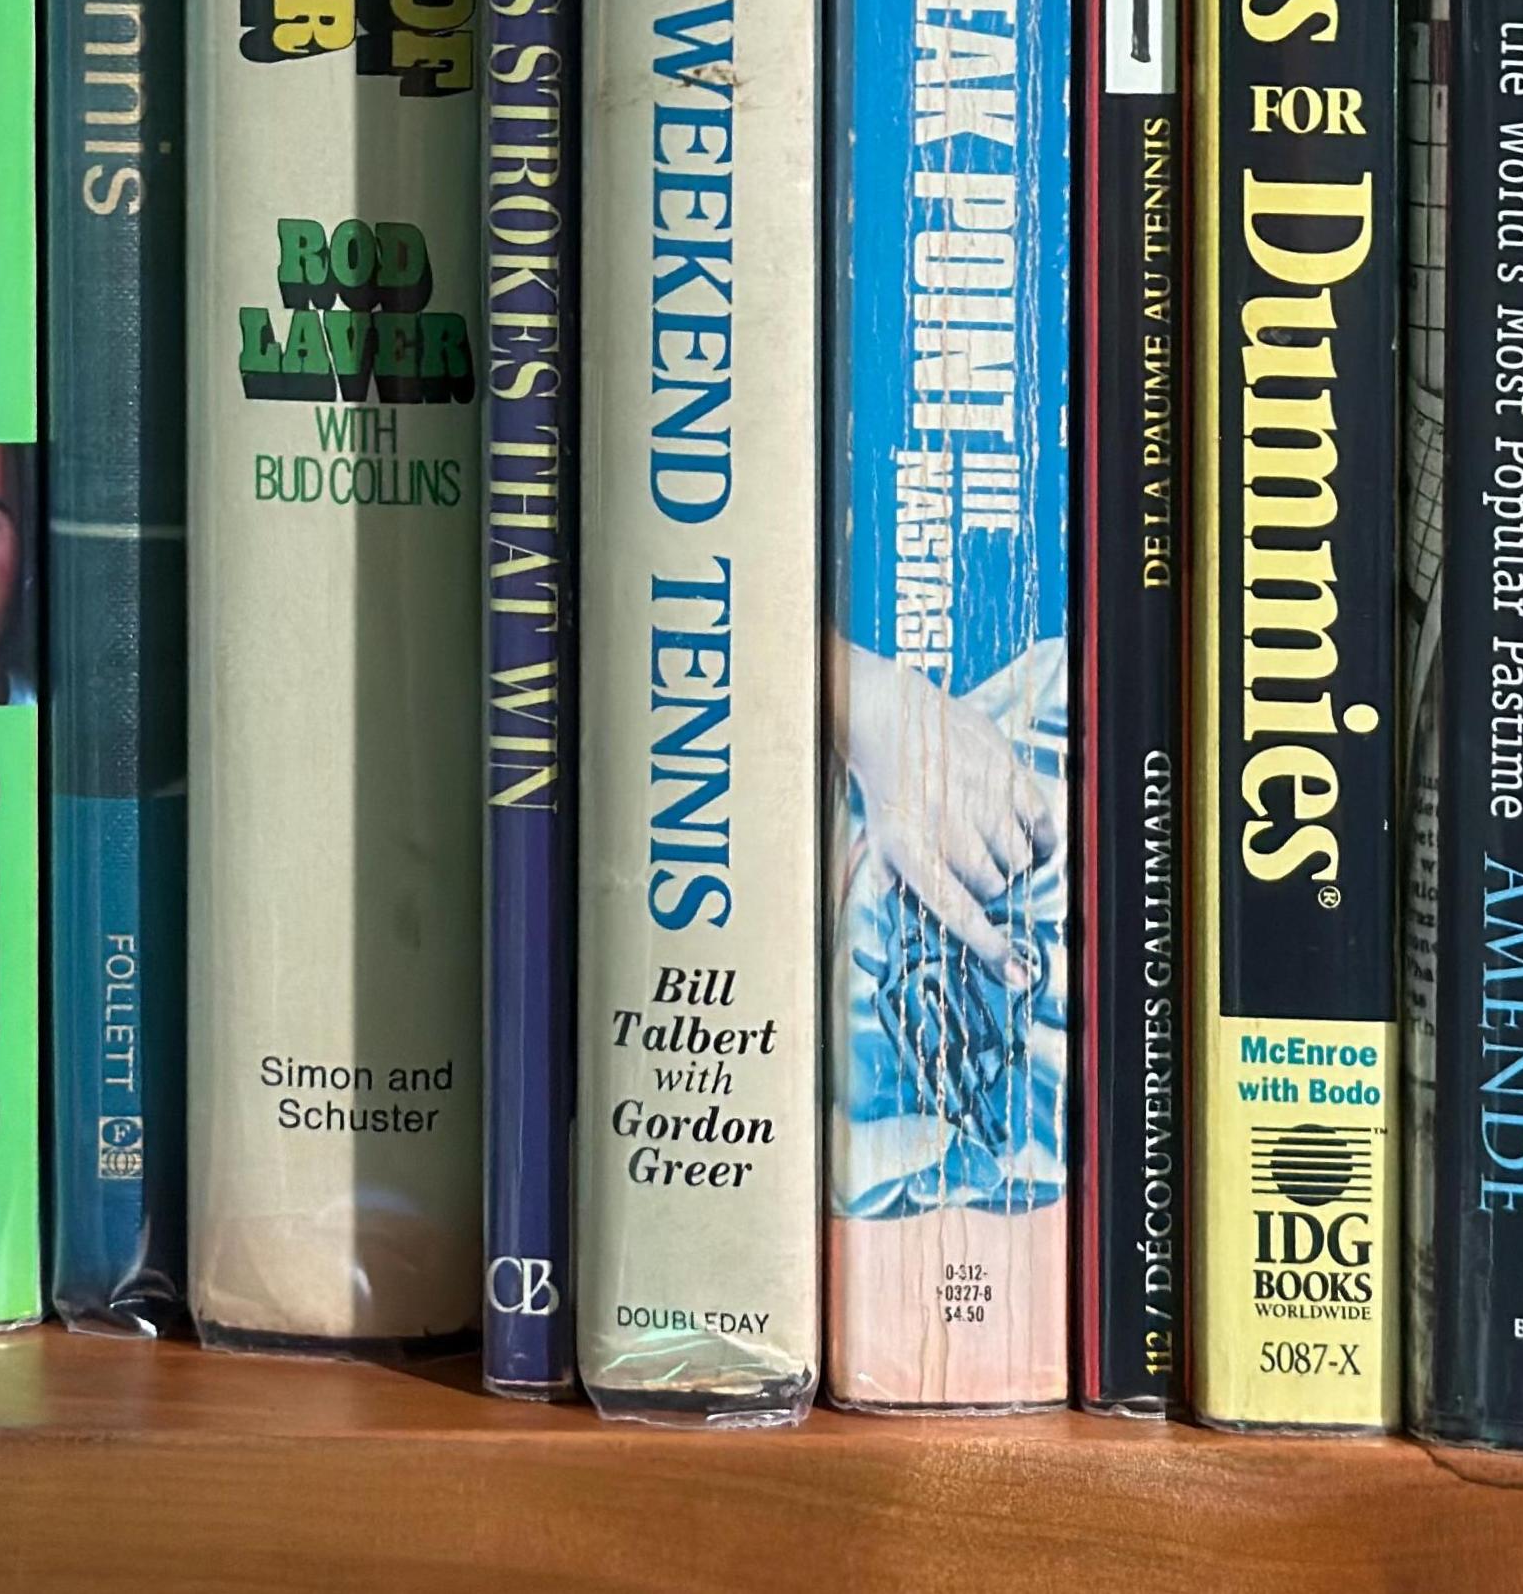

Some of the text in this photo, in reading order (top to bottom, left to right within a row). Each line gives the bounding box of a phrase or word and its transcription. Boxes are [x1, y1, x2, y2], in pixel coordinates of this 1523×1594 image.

[1249, 86, 1366, 135] FOR
[488, 43, 563, 400] STROKES
[277, 218, 433, 311] ROD
[913, 172, 1015, 442] POINT
[238, 306, 475, 403] LAVER
[1144, 118, 1172, 589] DE LA PAUME AU TENNIS
[488, 425, 559, 632] THAT
[895, 451, 954, 680] NASTASE
[487, 661, 558, 814] WIN
[648, 556, 731, 930] TENNIS
[652, 967, 736, 1007] Bill
[106, 934, 136, 1091] FOLLETT
[613, 1011, 777, 1055] Talbert
[260, 1056, 453, 1091] Simon and
[1137, 748, 1173, 1377] 112 DÉCOUVERTES GALLIMARD
[1241, 1036, 1378, 1067] McEnroe
[654, 1061, 733, 1095] with
[1238, 1078, 1380, 1106] with Bodo
[278, 1099, 438, 1133] Schuster
[612, 1100, 775, 1144] Gordon
[627, 1147, 753, 1188] Greer
[1254, 1210, 1373, 1265] IDG
[1253, 1270, 1373, 1303] BOOKS
[617, 1306, 770, 1334] DOUBLEDAY
[1254, 1303, 1371, 1320] WORLDWIDE
[1260, 1340, 1361, 1376] 5087-X
